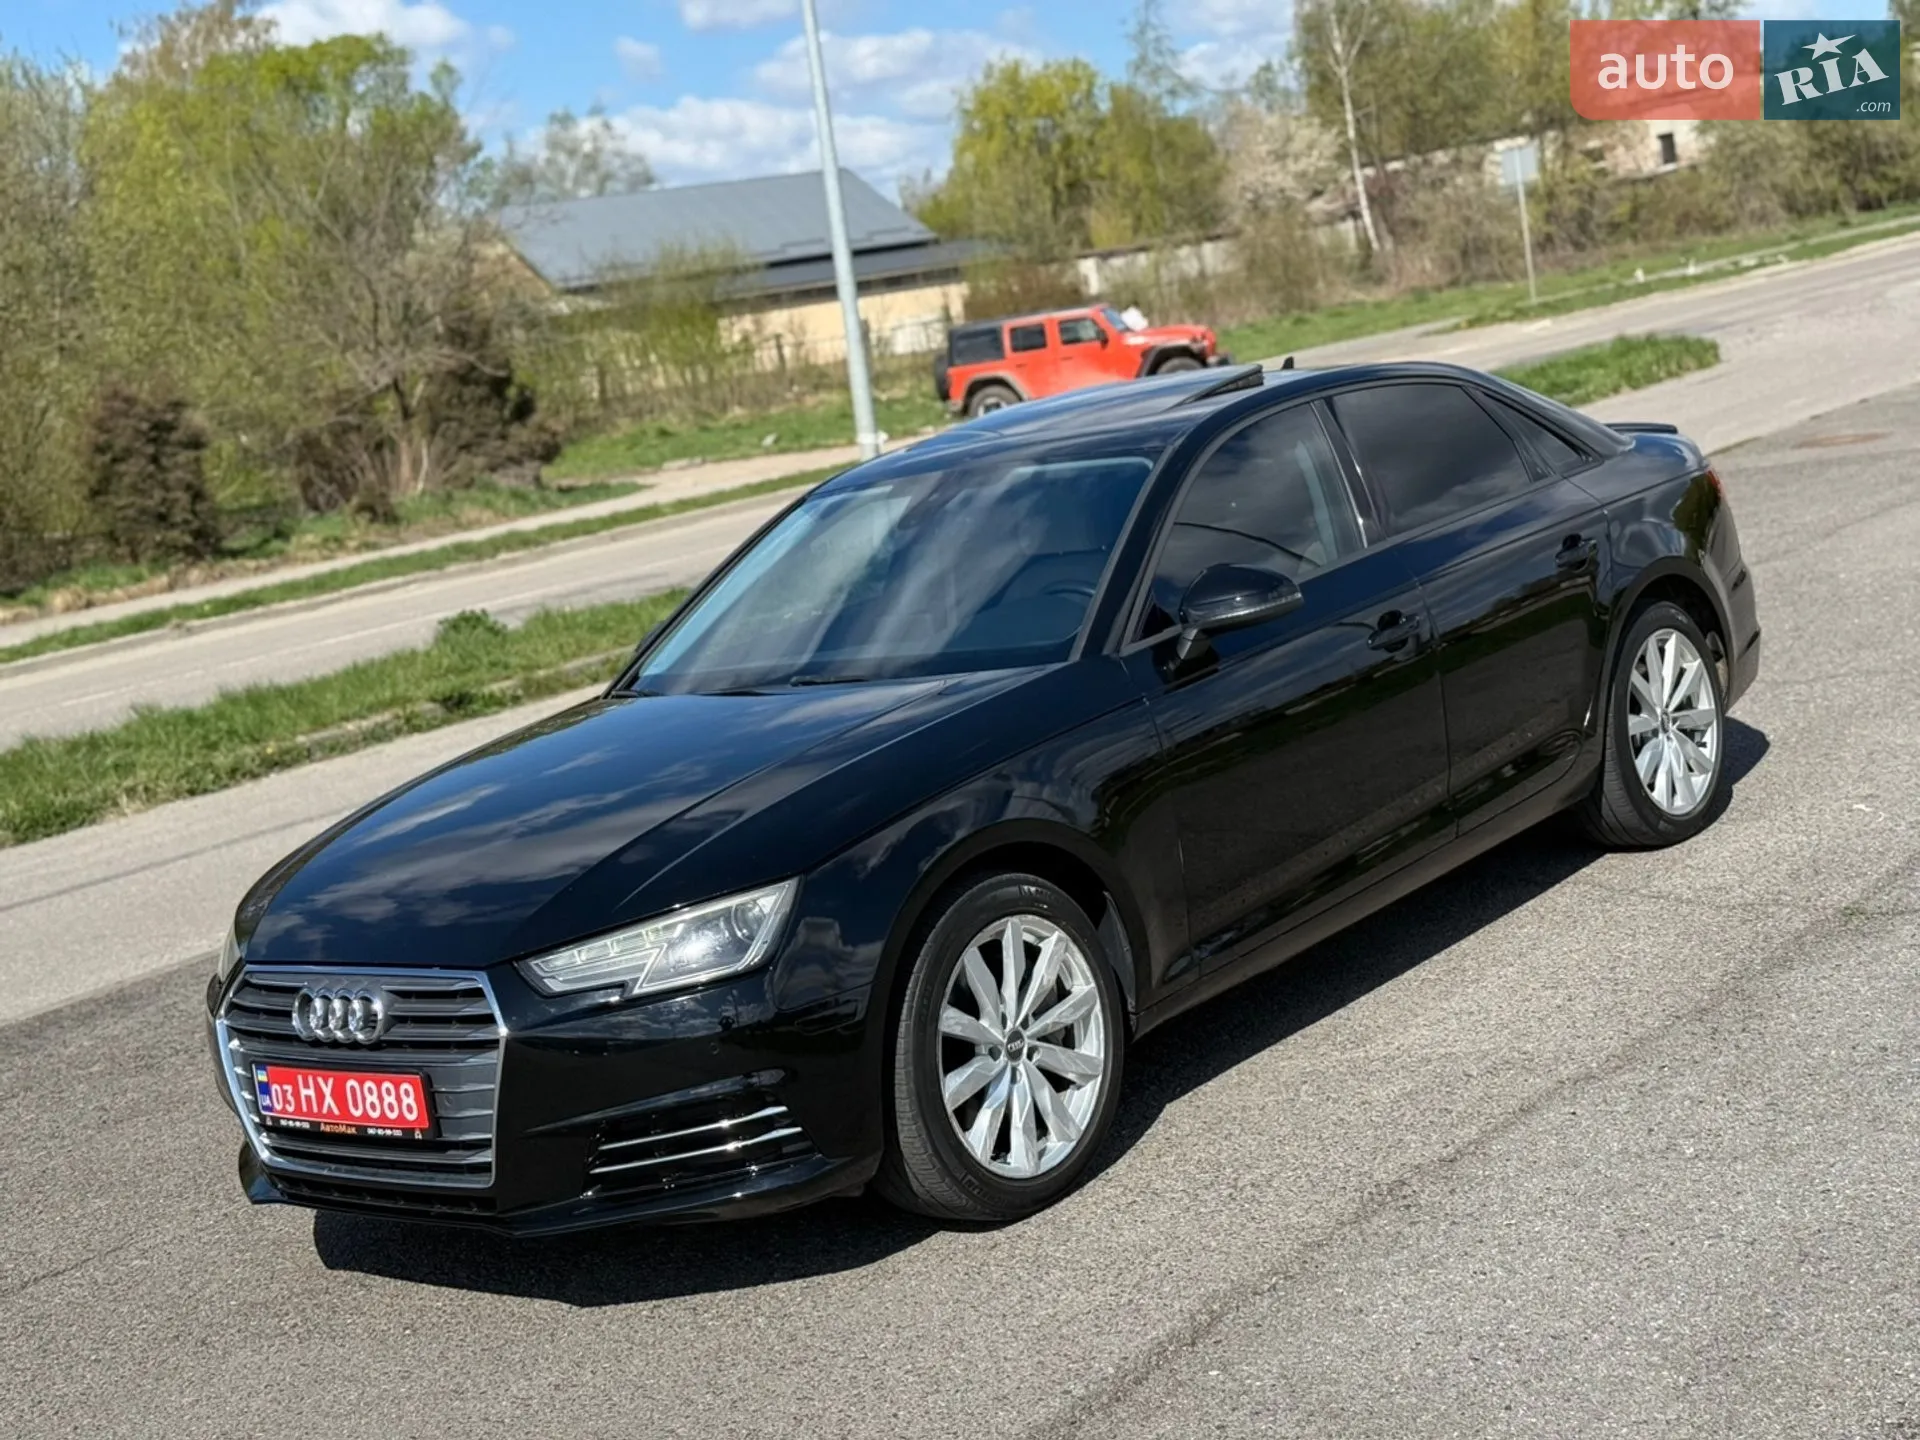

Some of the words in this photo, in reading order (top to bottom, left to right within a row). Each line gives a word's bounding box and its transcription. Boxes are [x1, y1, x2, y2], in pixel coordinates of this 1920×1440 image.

[271, 1084, 295, 1113] 03
[297, 1074, 340, 1115] HX
[345, 1078, 419, 1121] 0888
